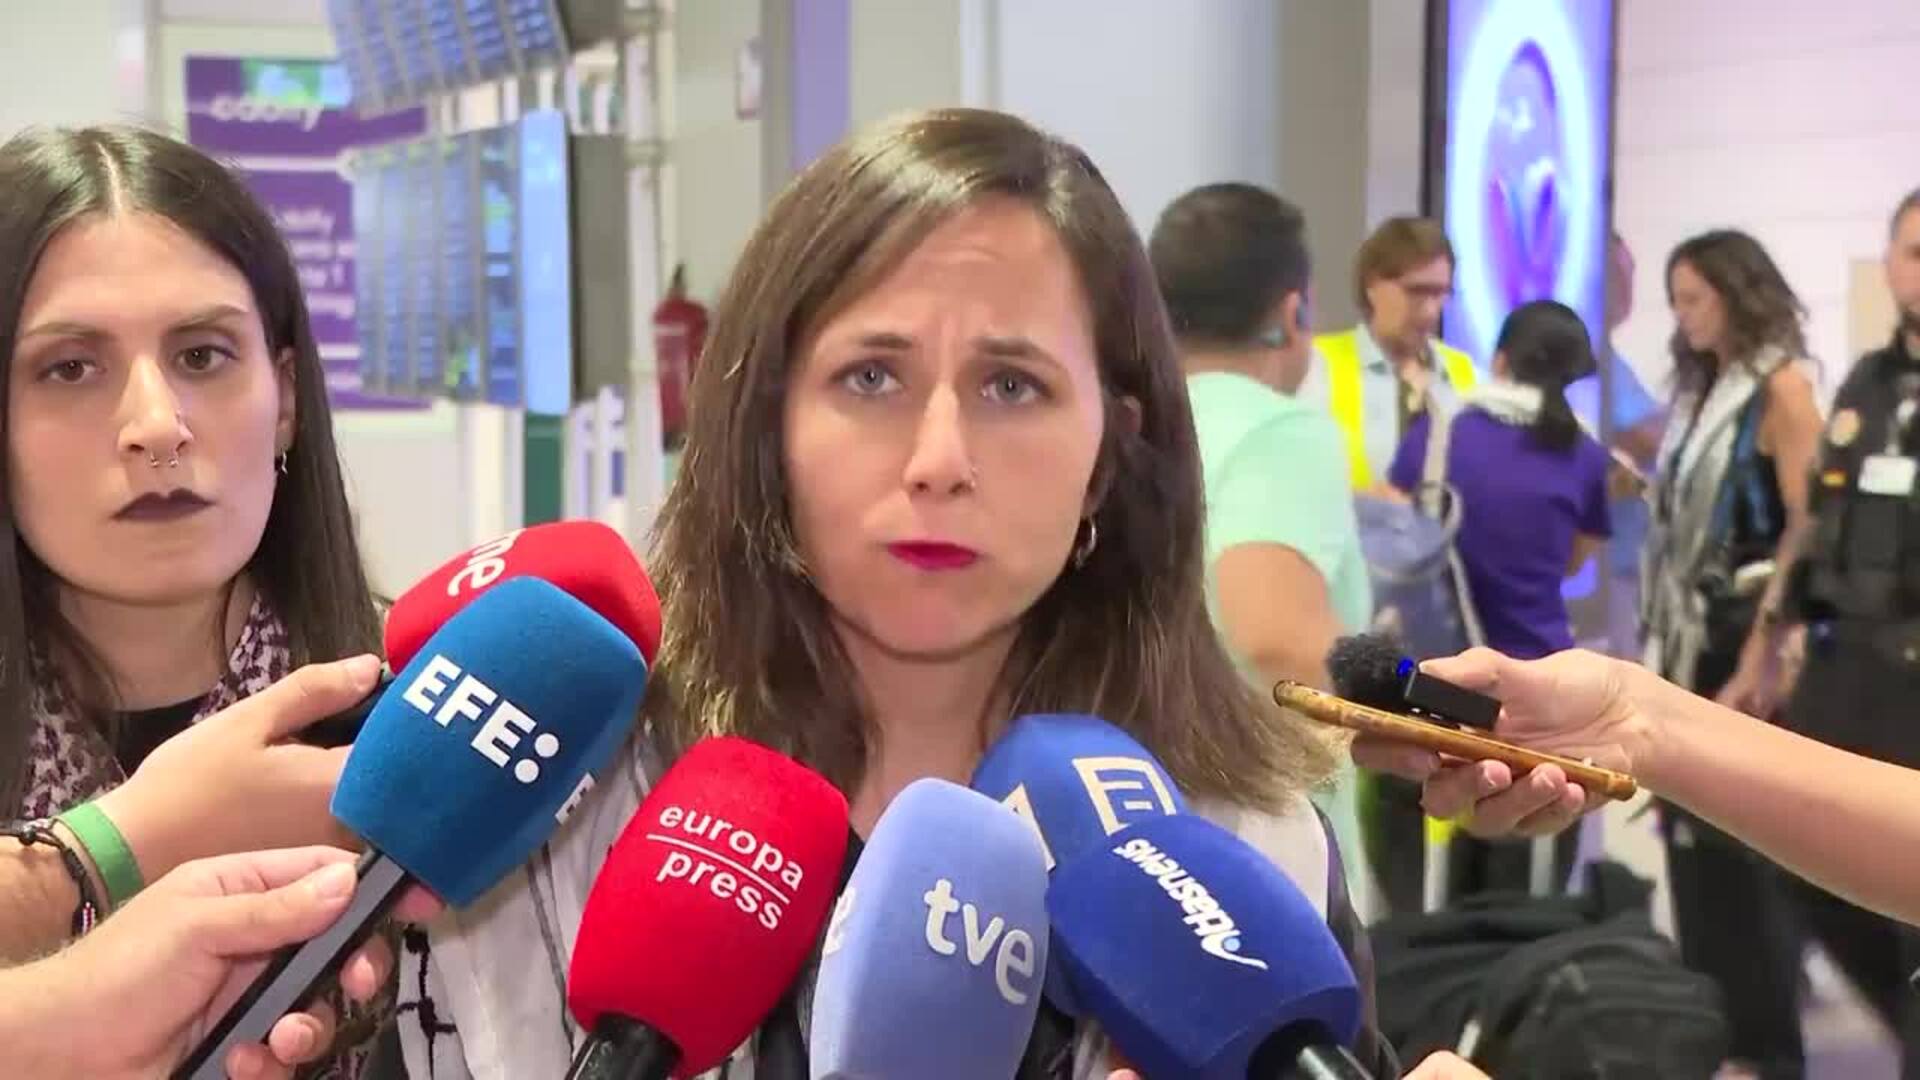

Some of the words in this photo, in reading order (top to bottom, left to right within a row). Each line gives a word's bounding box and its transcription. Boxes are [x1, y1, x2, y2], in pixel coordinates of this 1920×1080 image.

[655, 849, 783, 930] press
[659, 803, 805, 892] europa
[923, 878, 1035, 1006] tve
